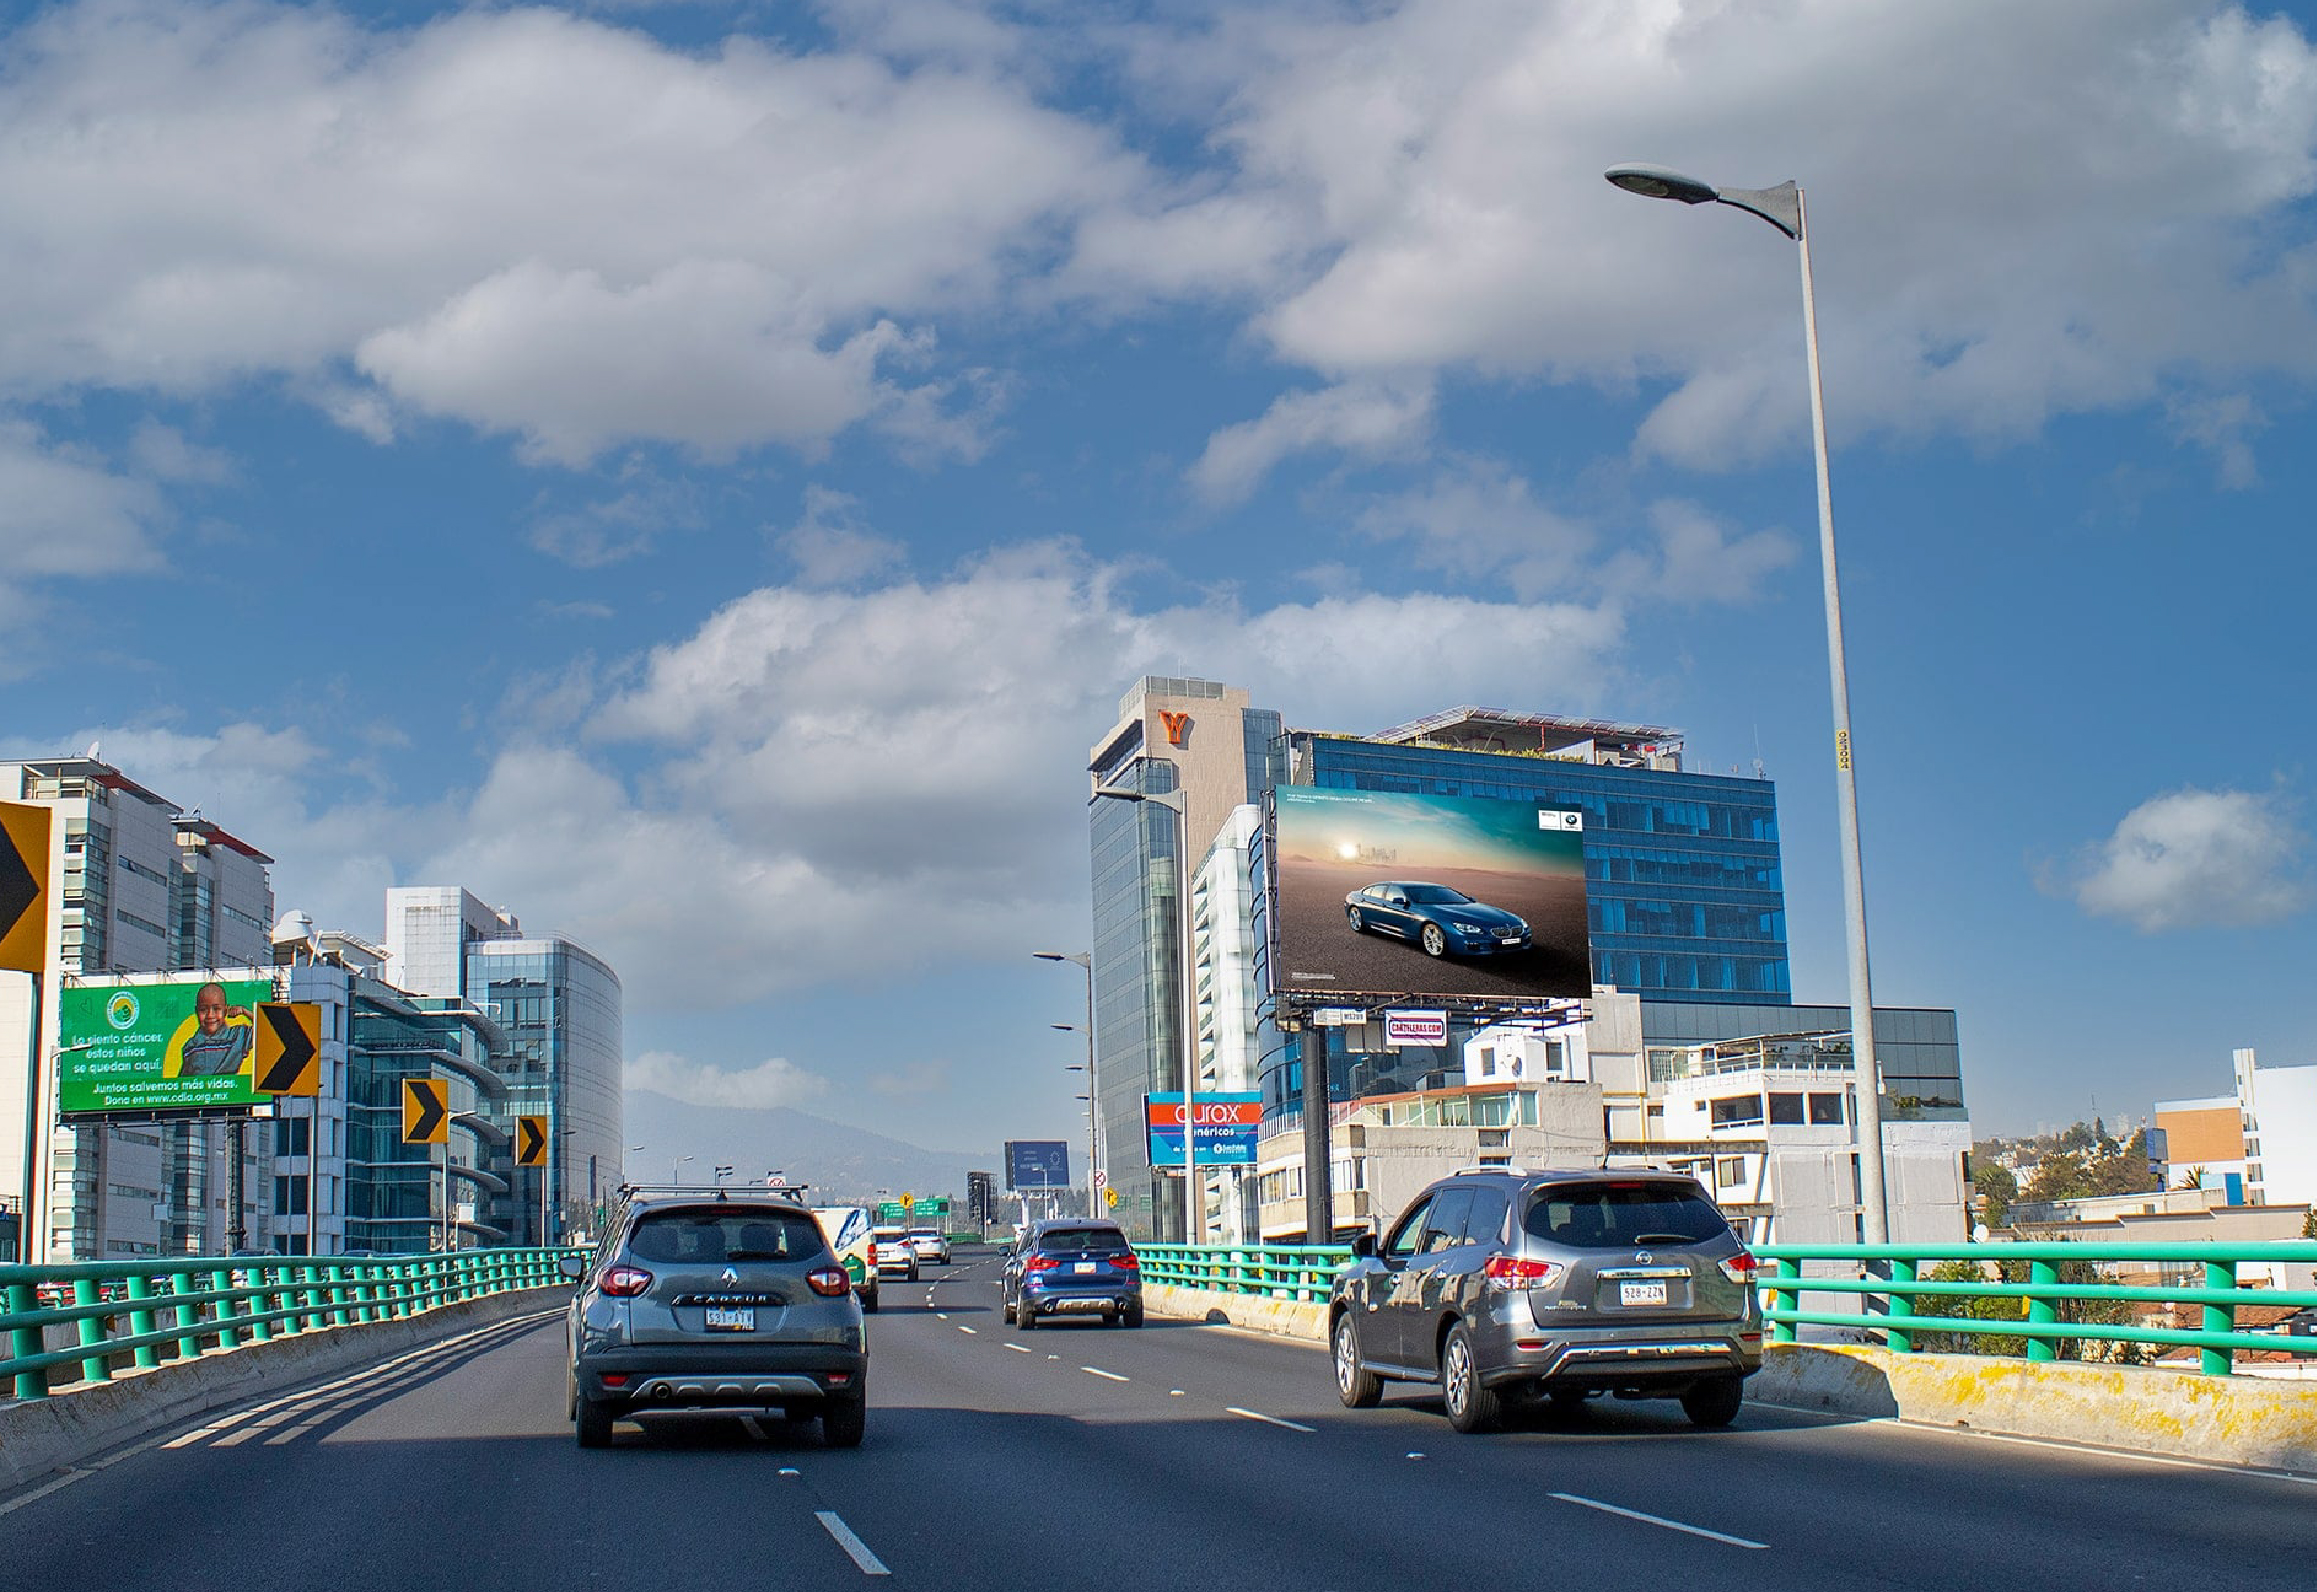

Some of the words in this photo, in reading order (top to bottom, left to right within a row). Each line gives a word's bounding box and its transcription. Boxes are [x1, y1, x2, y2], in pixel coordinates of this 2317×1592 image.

[86, 1047, 115, 1058] estos
[117, 1046, 147, 1057] niños
[73, 1063, 87, 1073] se
[89, 1060, 131, 1074] quedan
[93, 1082, 128, 1094] Juntos
[129, 1080, 179, 1092] salvemos
[181, 1078, 204, 1089] más
[105, 1095, 130, 1105] Dona
[132, 1095, 145, 1104] en
